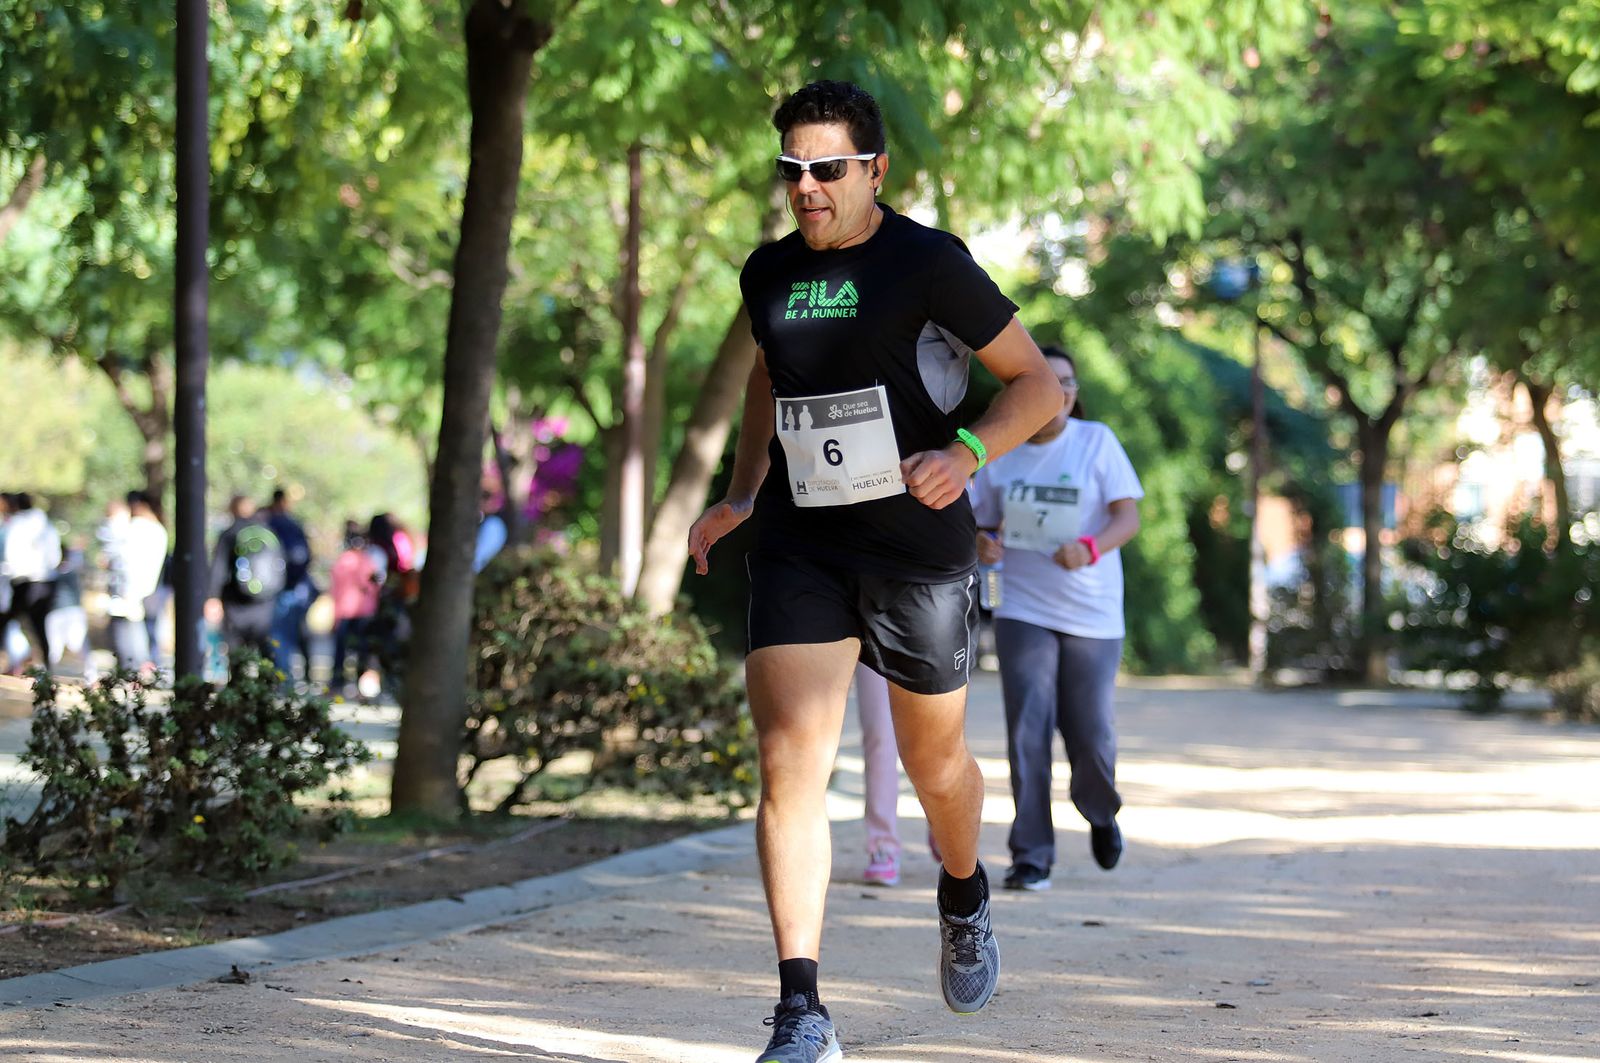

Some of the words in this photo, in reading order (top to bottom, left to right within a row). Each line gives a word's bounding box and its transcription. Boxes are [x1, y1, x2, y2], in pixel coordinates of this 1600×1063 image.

[788, 280, 859, 308] FILA
[785, 310, 798, 319] BE
[801, 310, 808, 319] A
[812, 308, 857, 318] RUNNER
[843, 403, 856, 411] Que
[853, 406, 878, 416] Huelva
[823, 439, 843, 466] 6
[852, 477, 889, 490] HUELVA
[1036, 511, 1048, 527] 7
